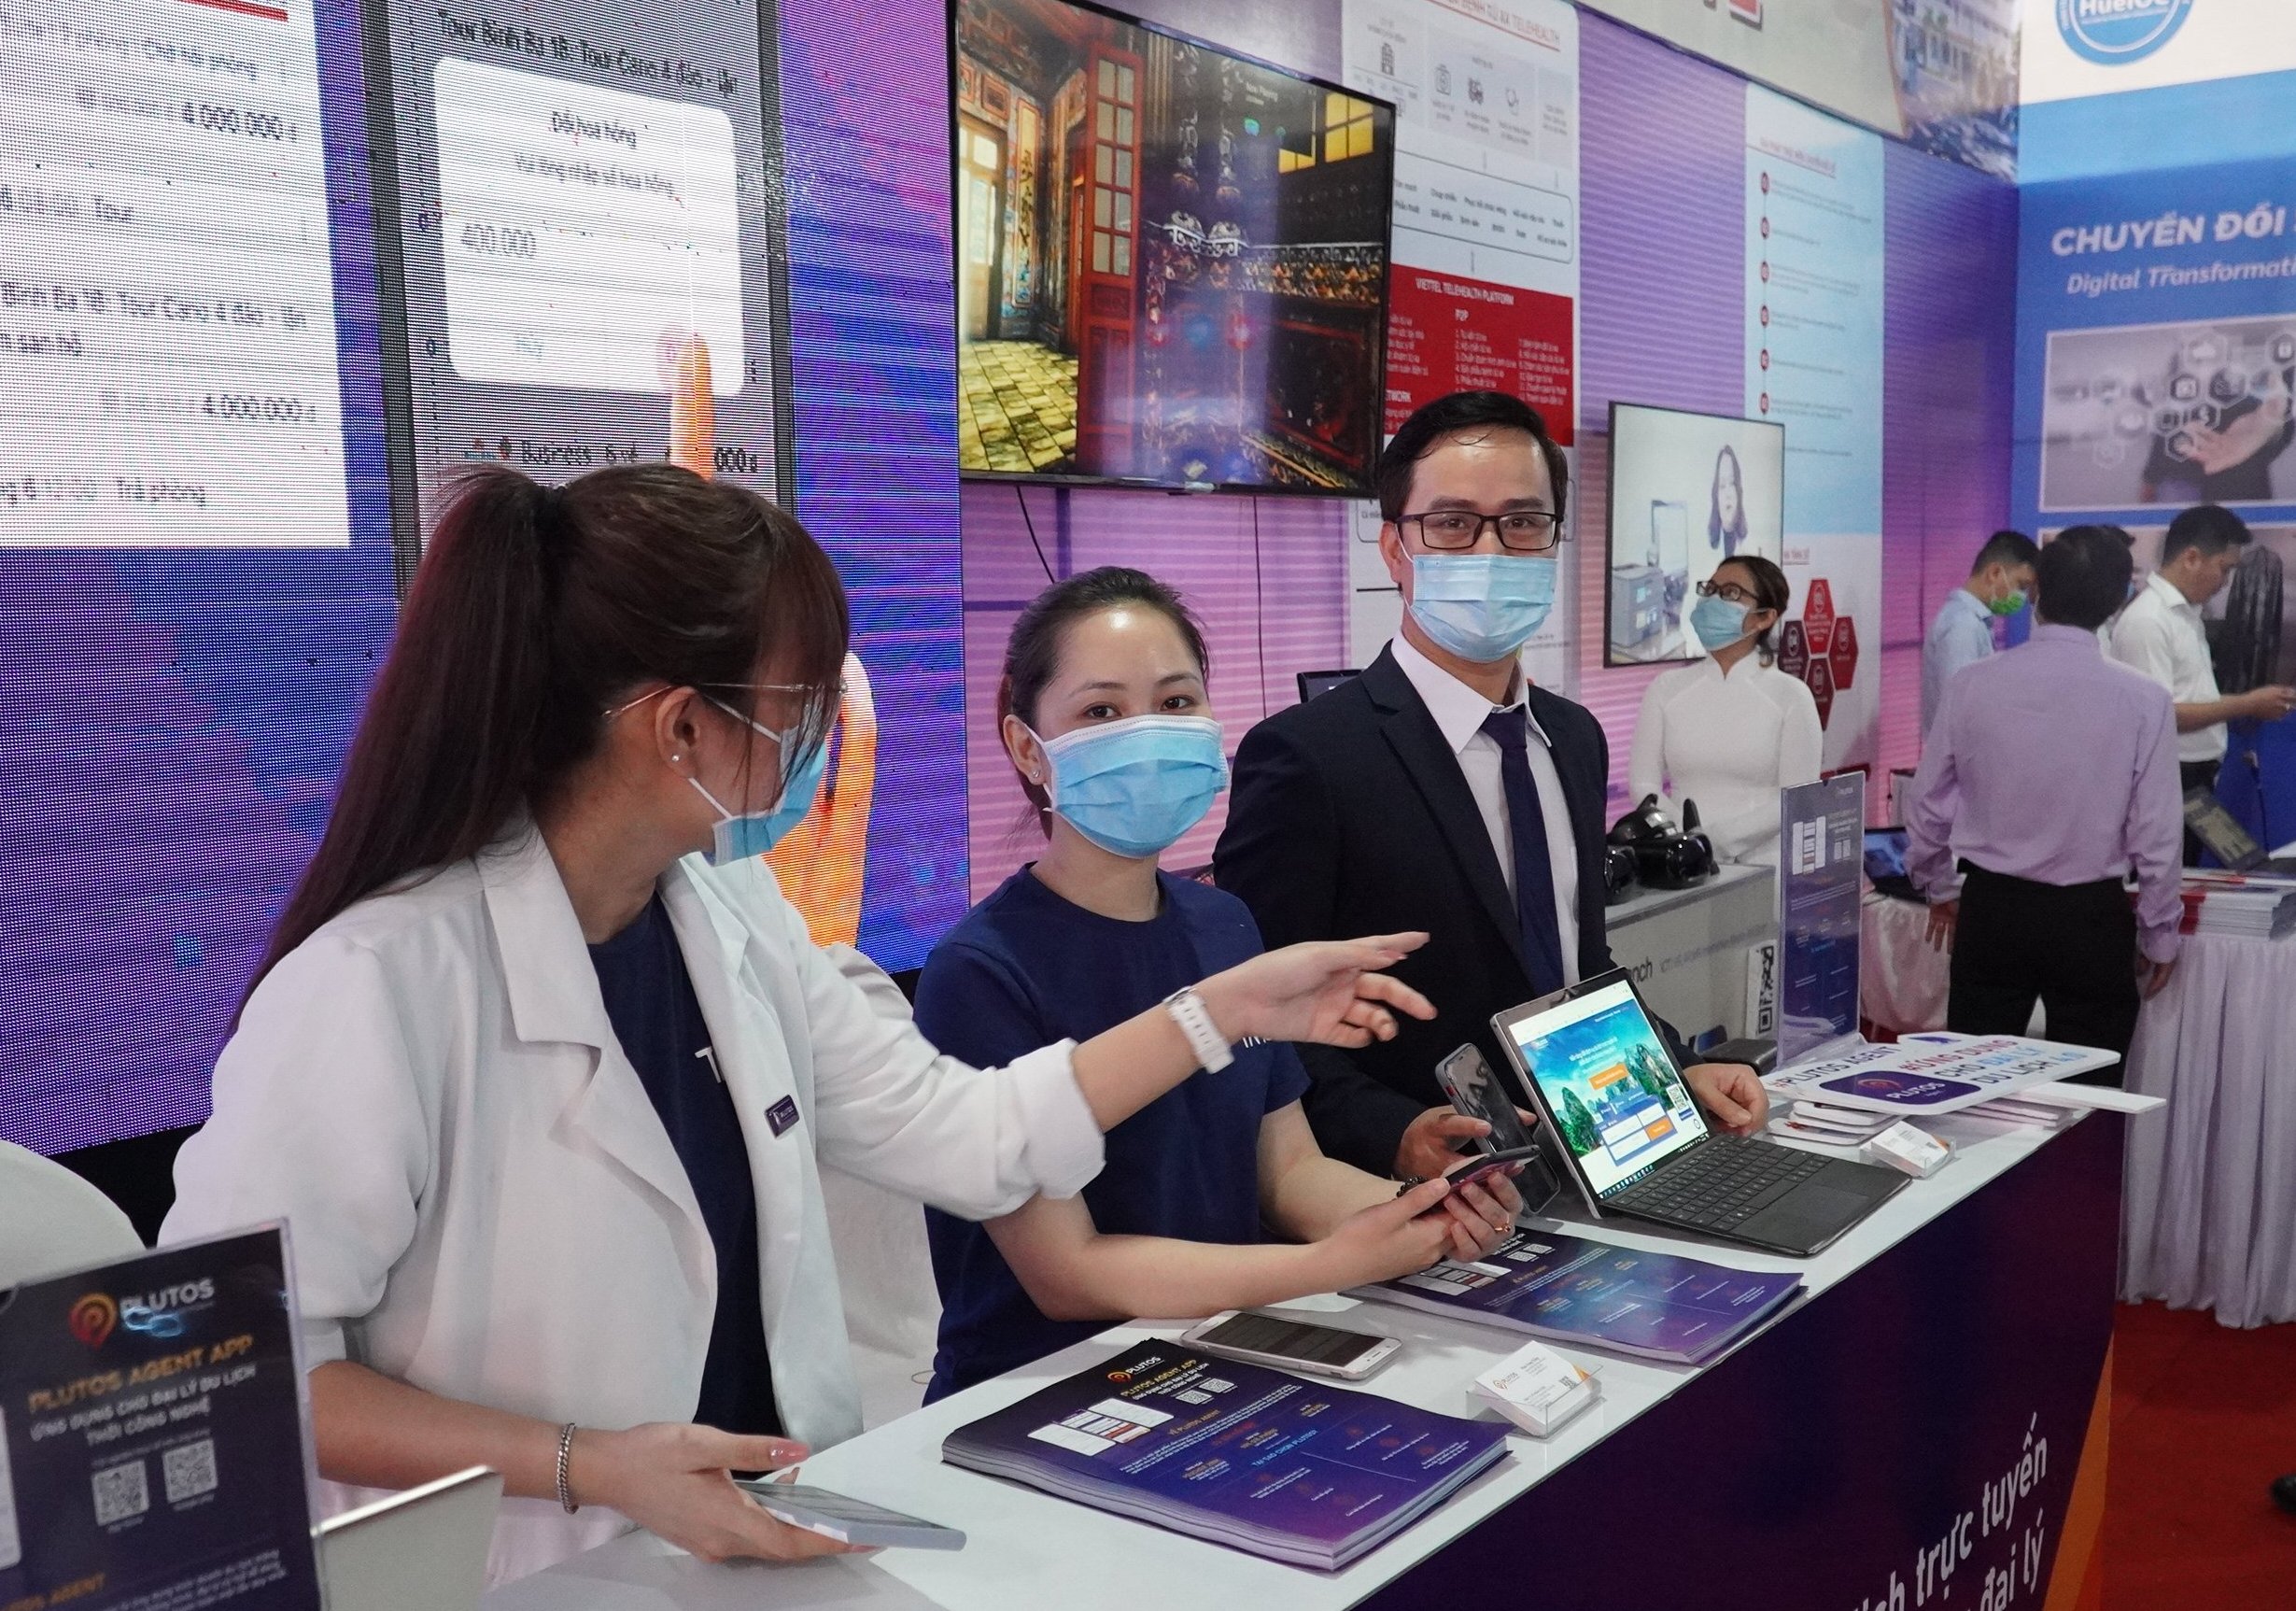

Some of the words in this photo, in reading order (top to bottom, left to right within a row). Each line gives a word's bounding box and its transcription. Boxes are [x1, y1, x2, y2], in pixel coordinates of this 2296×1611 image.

[2050, 210, 2205, 256] CHUYỂN
[2214, 201, 2287, 242] ĐỔI
[2066, 268, 2140, 299] Digital
[1845, 1045, 1901, 1067] AGENT
[1935, 1061, 1979, 1079] CHO
[1885, 1081, 1947, 1101] PLUTOS
[120, 1277, 215, 1310] PLUTOS
[28, 1369, 123, 1413] PLUTOS
[128, 1347, 204, 1386] AGENT
[210, 1334, 254, 1364] APP
[1120, 1379, 1156, 1397] PLUTOS
[1154, 1366, 1182, 1383] AGENT
[1181, 1359, 1197, 1371] APP
[1125, 1355, 1162, 1375] PLUTOS
[1916, 1512, 1974, 1608] trực
[1981, 1411, 2048, 1538] tuyến
[2023, 1507, 2045, 1594] lý
